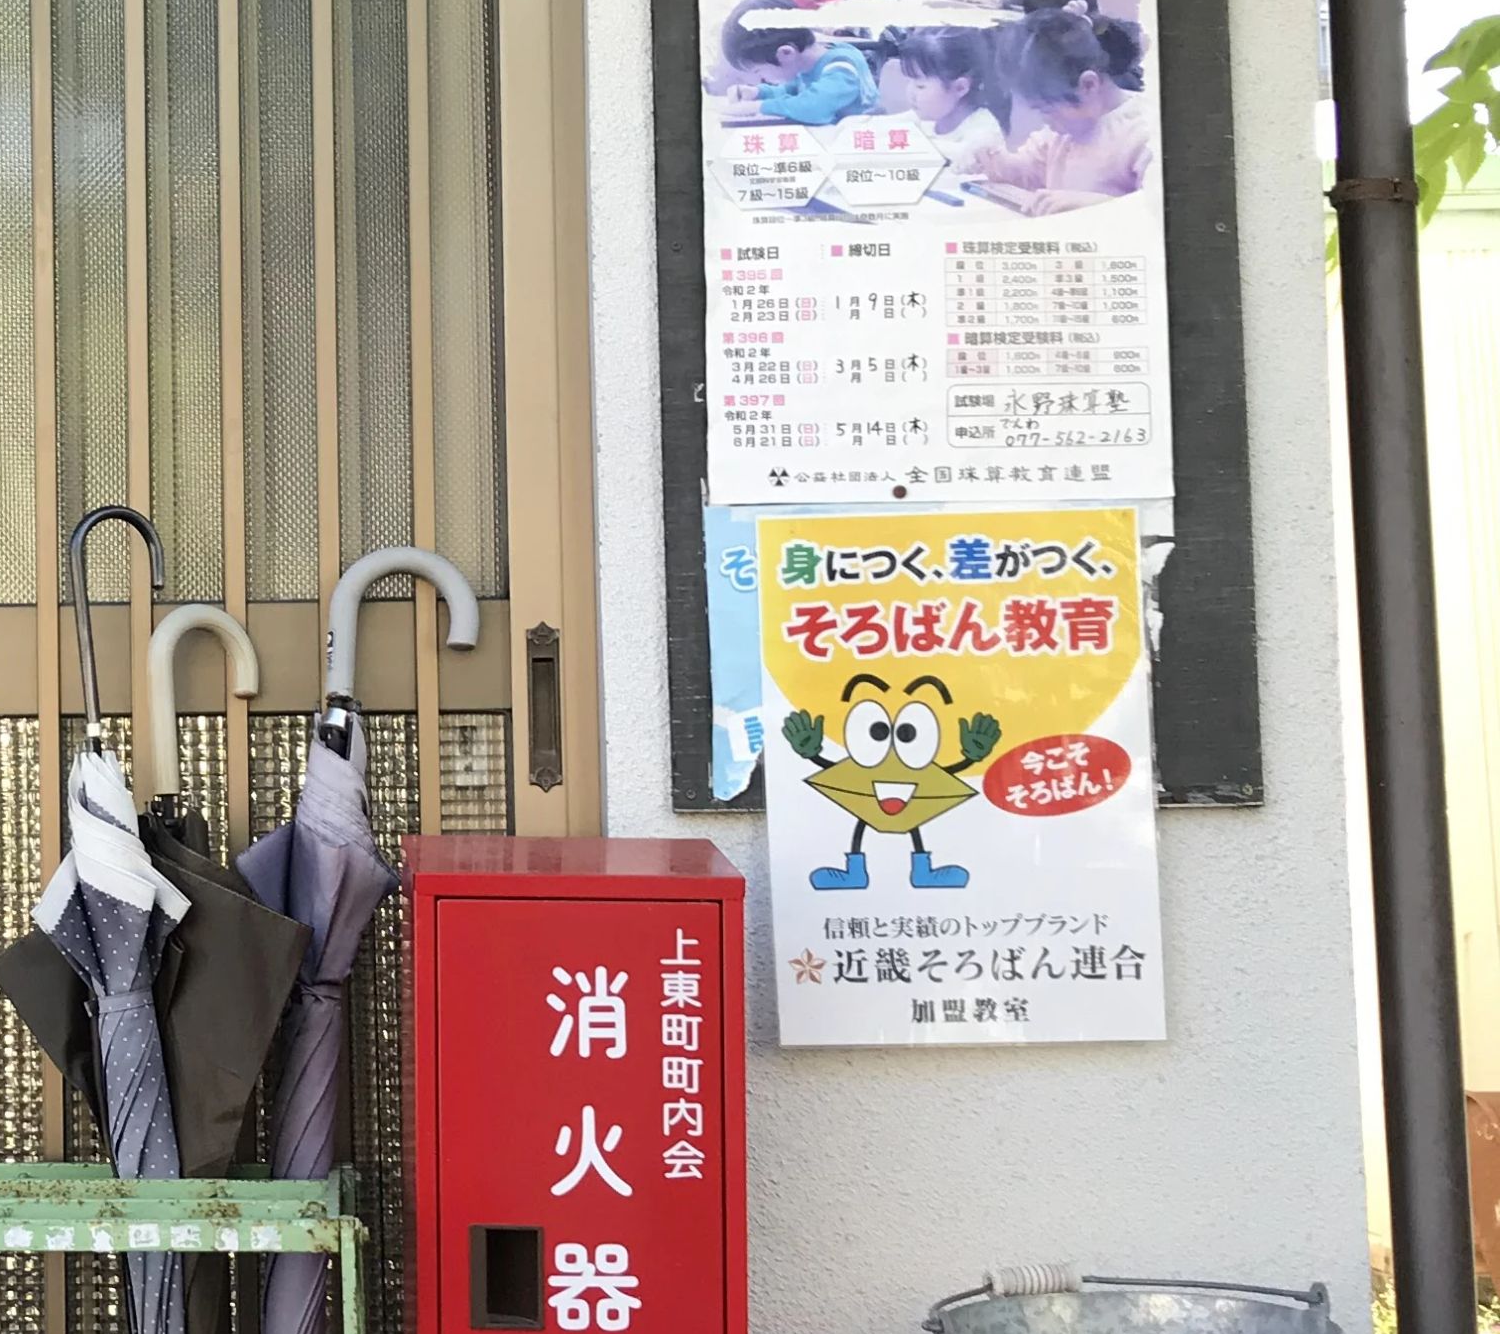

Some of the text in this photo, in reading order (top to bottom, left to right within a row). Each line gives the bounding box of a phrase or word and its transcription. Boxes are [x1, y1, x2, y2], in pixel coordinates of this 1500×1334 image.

[743, 132, 799, 154] 珠算
[853, 129, 910, 150] 暗算
[737, 246, 779, 260] 試験日
[904, 464, 1112, 485] 全国珠算教育連盟
[781, 538, 1114, 585] 身につく、差がつく、
[786, 598, 1115, 658] そろばん教育
[1022, 741, 1090, 771] 今こそ
[823, 913, 1109, 939] 信頼と実績のトップブランド
[833, 944, 1147, 985] 近畿そろばん連合
[911, 998, 1031, 1024] 加盟教室
[659, 928, 706, 1180] 上東町町内会
[545, 965, 643, 1332] 消火器
